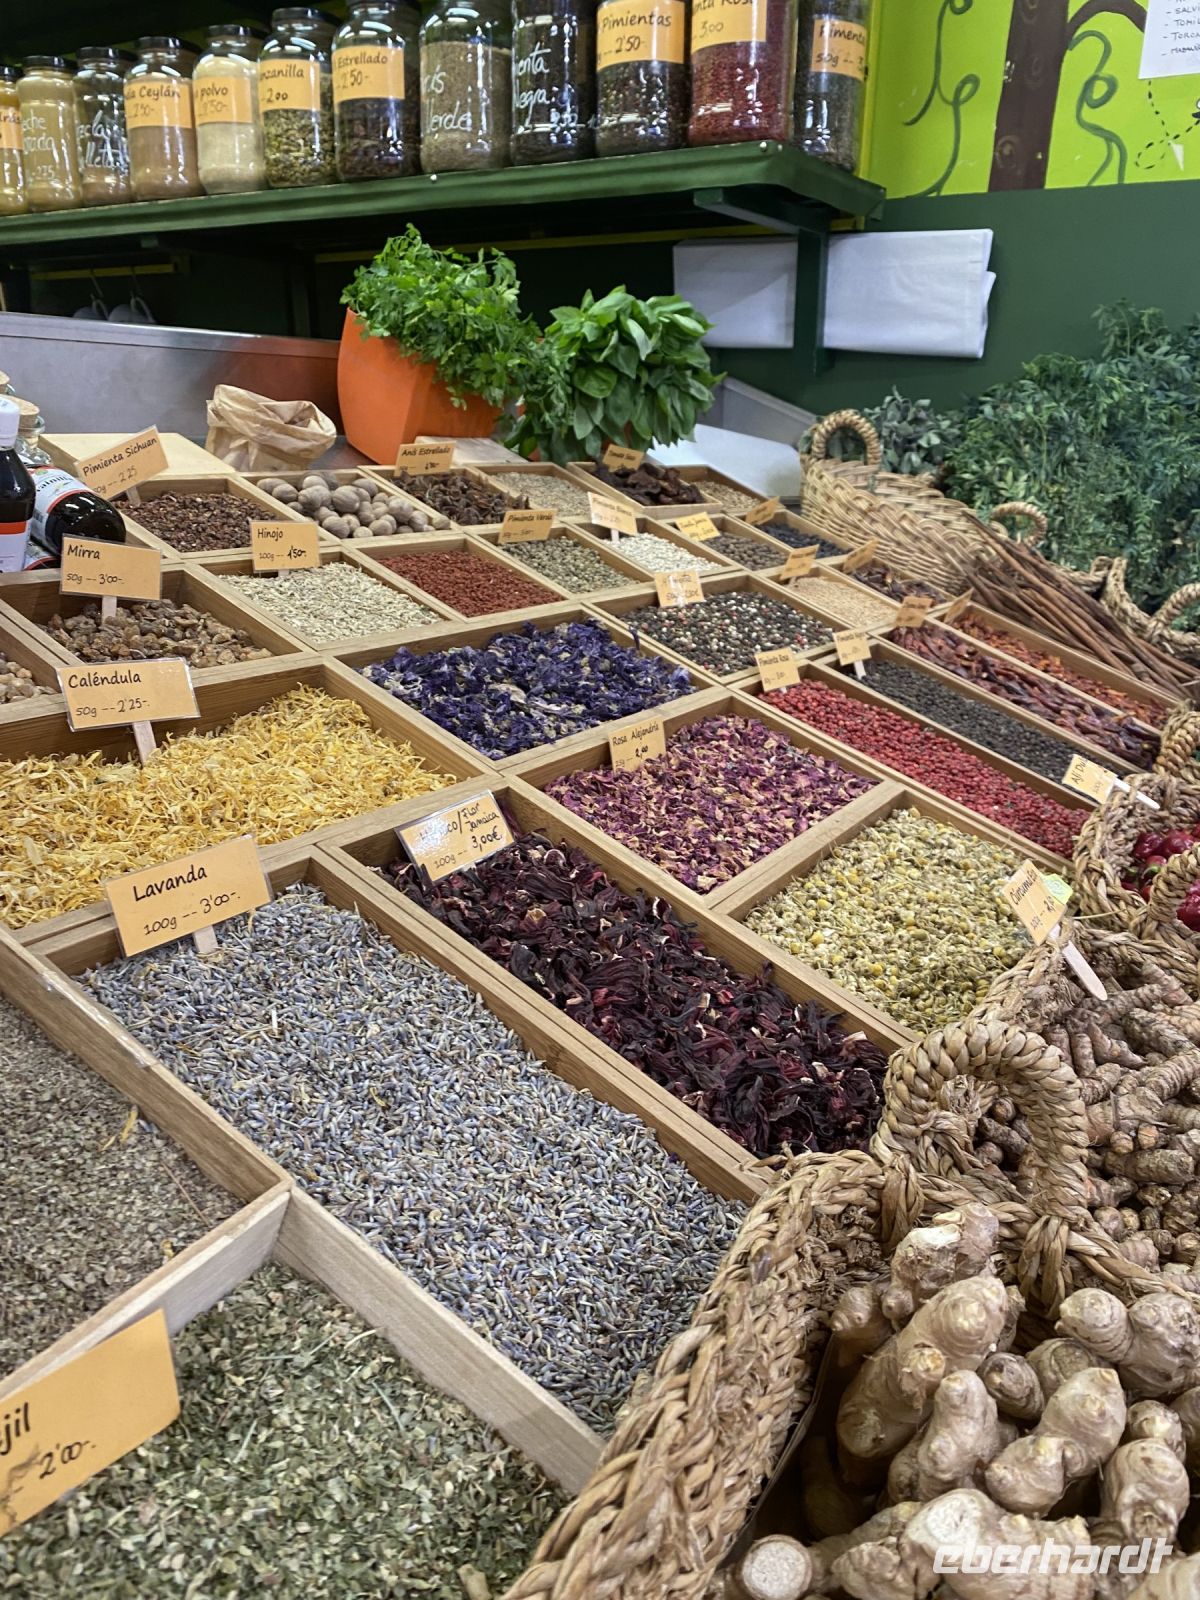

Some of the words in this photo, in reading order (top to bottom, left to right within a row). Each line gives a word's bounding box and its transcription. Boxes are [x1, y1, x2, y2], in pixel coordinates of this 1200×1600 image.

[602, 10, 672, 34] Pimientas
[199, 84, 229, 100] polvo
[82, 453, 124, 477] Pimienta
[125, 438, 157, 458] Sichuan
[257, 527, 283, 541] Hinojo
[67, 543, 100, 560] Mirra
[66, 573, 82, 584] 50g
[67, 669, 142, 689] Caléndula
[75, 705, 97, 717] 50g
[612, 735, 627, 746] Rosa
[133, 864, 208, 902] Lavanda
[143, 915, 178, 936] 100g
[0, 1402, 31, 1456] jil
